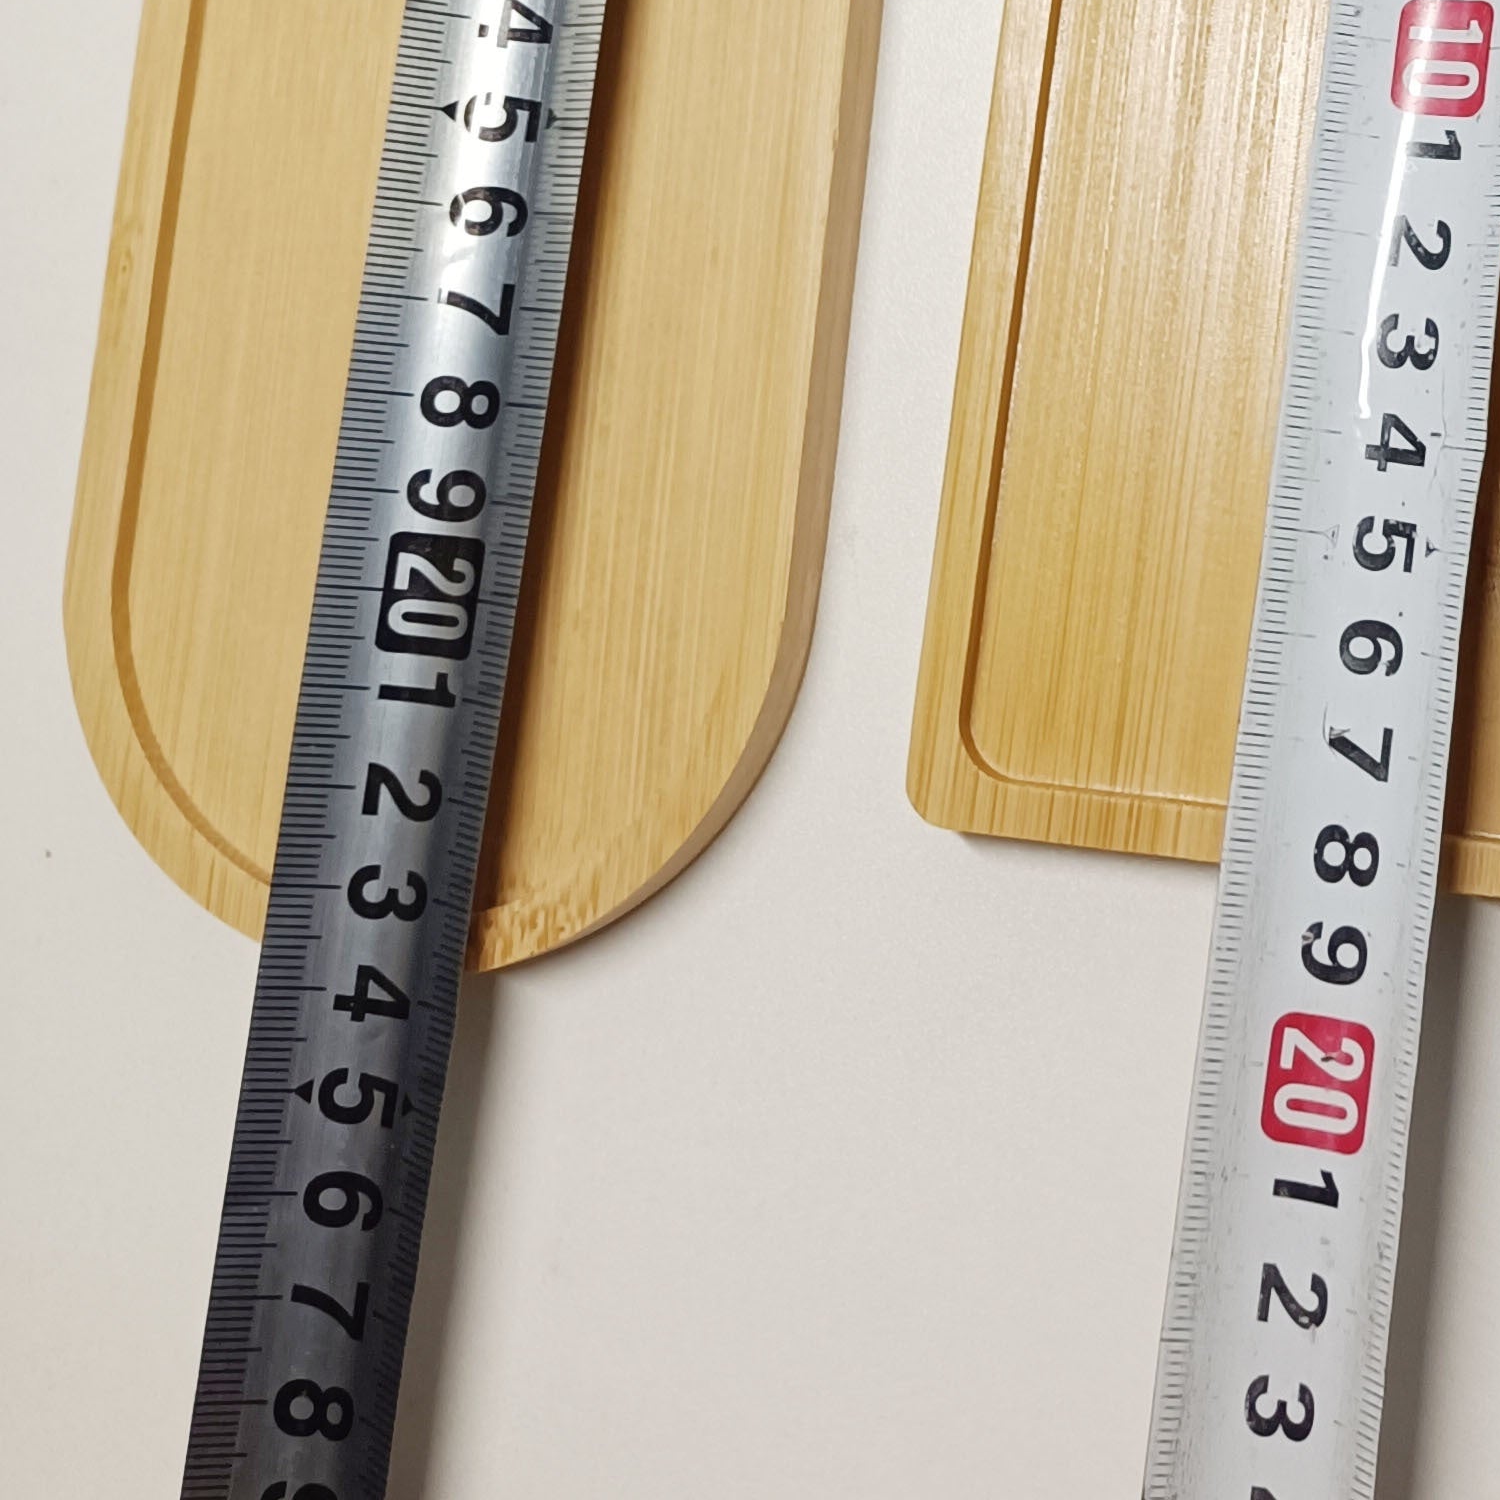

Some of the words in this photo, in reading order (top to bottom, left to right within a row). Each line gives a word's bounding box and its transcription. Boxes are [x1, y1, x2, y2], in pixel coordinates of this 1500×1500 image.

[1402, 19, 1481, 100] 10
[463, 92, 542, 144] 5
[1405, 130, 1461, 161] 1
[448, 186, 528, 238] 6
[1388, 214, 1452, 271] 2
[437, 283, 516, 336] 7
[1376, 313, 1440, 371] 3
[419, 375, 500, 430] 8
[1364, 413, 1426, 473] 4
[406, 468, 487, 523] 9
[1352, 515, 1418, 573] 5
[387, 552, 475, 643] 20
[1339, 619, 1404, 676] 6
[377, 672, 457, 709] 1
[1328, 727, 1393, 782] 7
[361, 762, 443, 823] 2
[1313, 824, 1380, 888] 8
[346, 864, 428, 925] 3
[1301, 921, 1368, 986] 9
[333, 965, 411, 1023] 4
[317, 1067, 399, 1128] 5
[1273, 1027, 1366, 1136] 20
[302, 1170, 383, 1232] 6
[1272, 1170, 1339, 1208] 1
[291, 1282, 369, 1342] 7
[1257, 1262, 1328, 1330] 2
[273, 1378, 354, 1442] 8
[1245, 1375, 1315, 1442] 3
